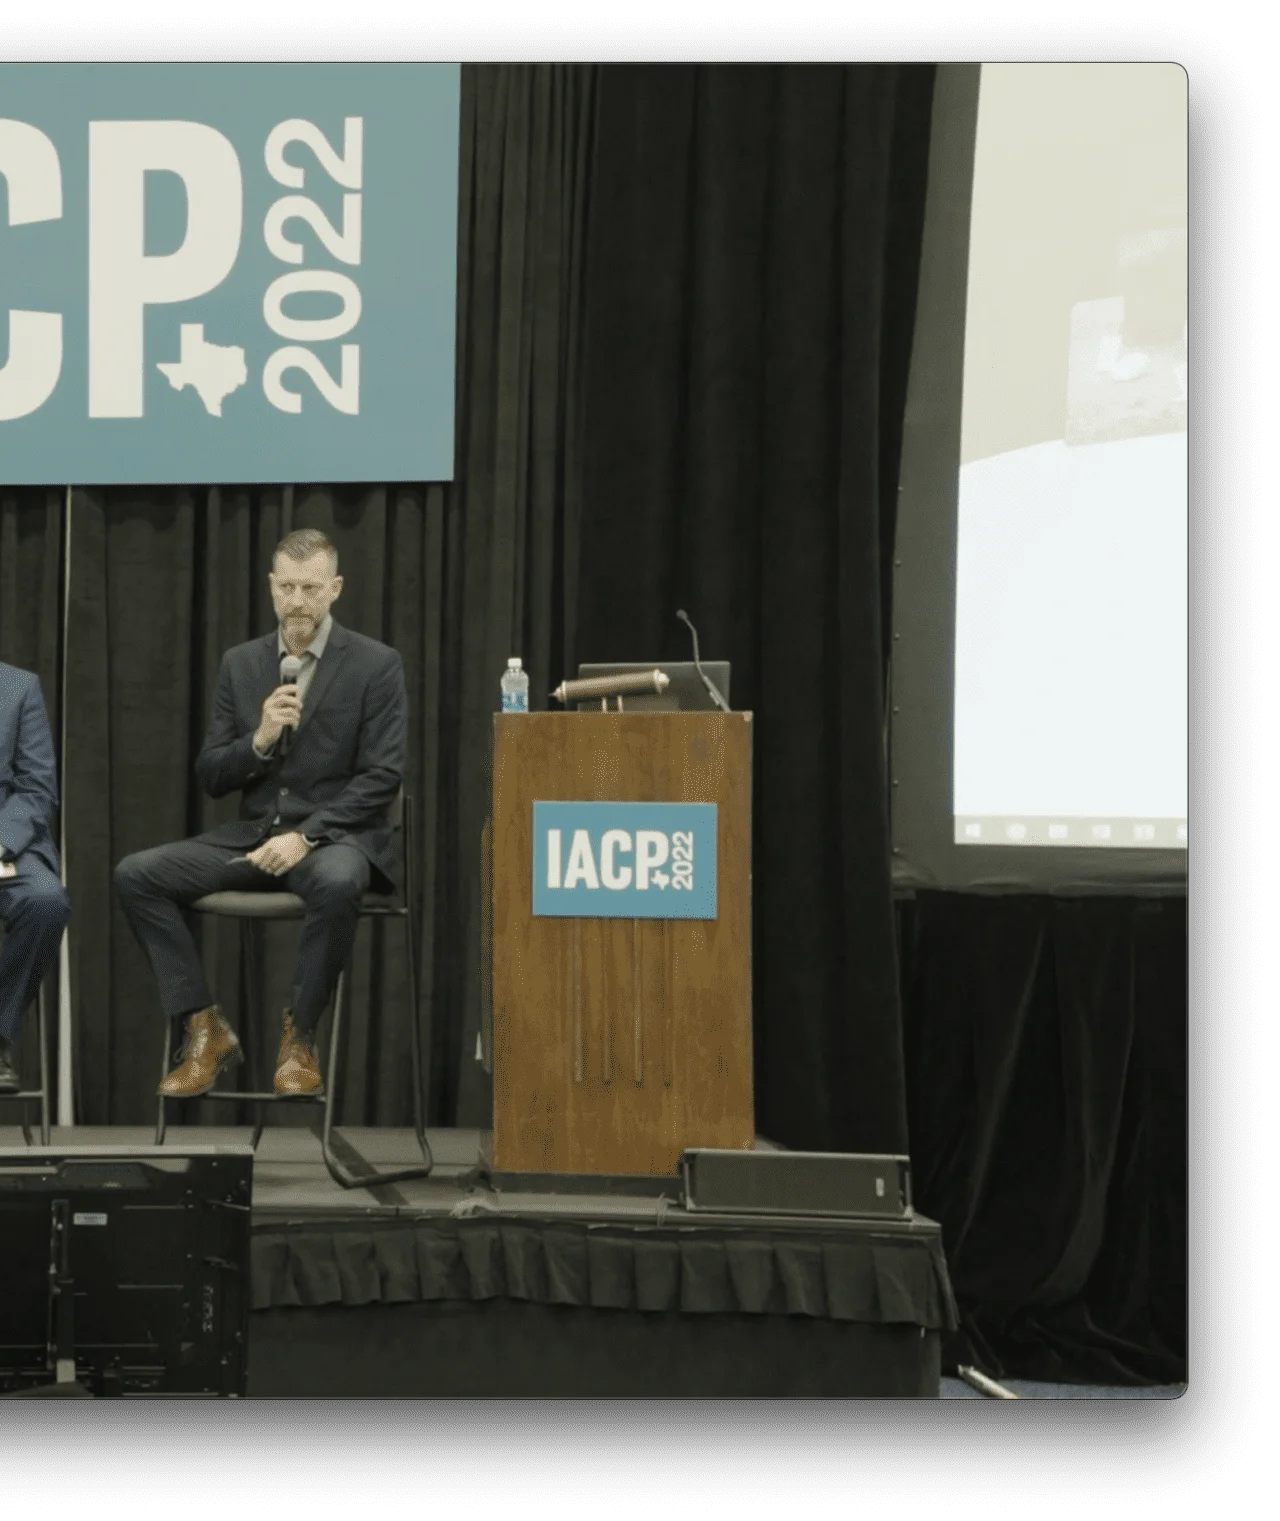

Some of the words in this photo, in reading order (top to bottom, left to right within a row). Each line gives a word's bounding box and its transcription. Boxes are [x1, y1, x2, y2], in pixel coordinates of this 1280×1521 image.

[263, 117, 363, 416] 2022
[547, 829, 670, 891] IACP
[672, 831, 694, 890] 2022
